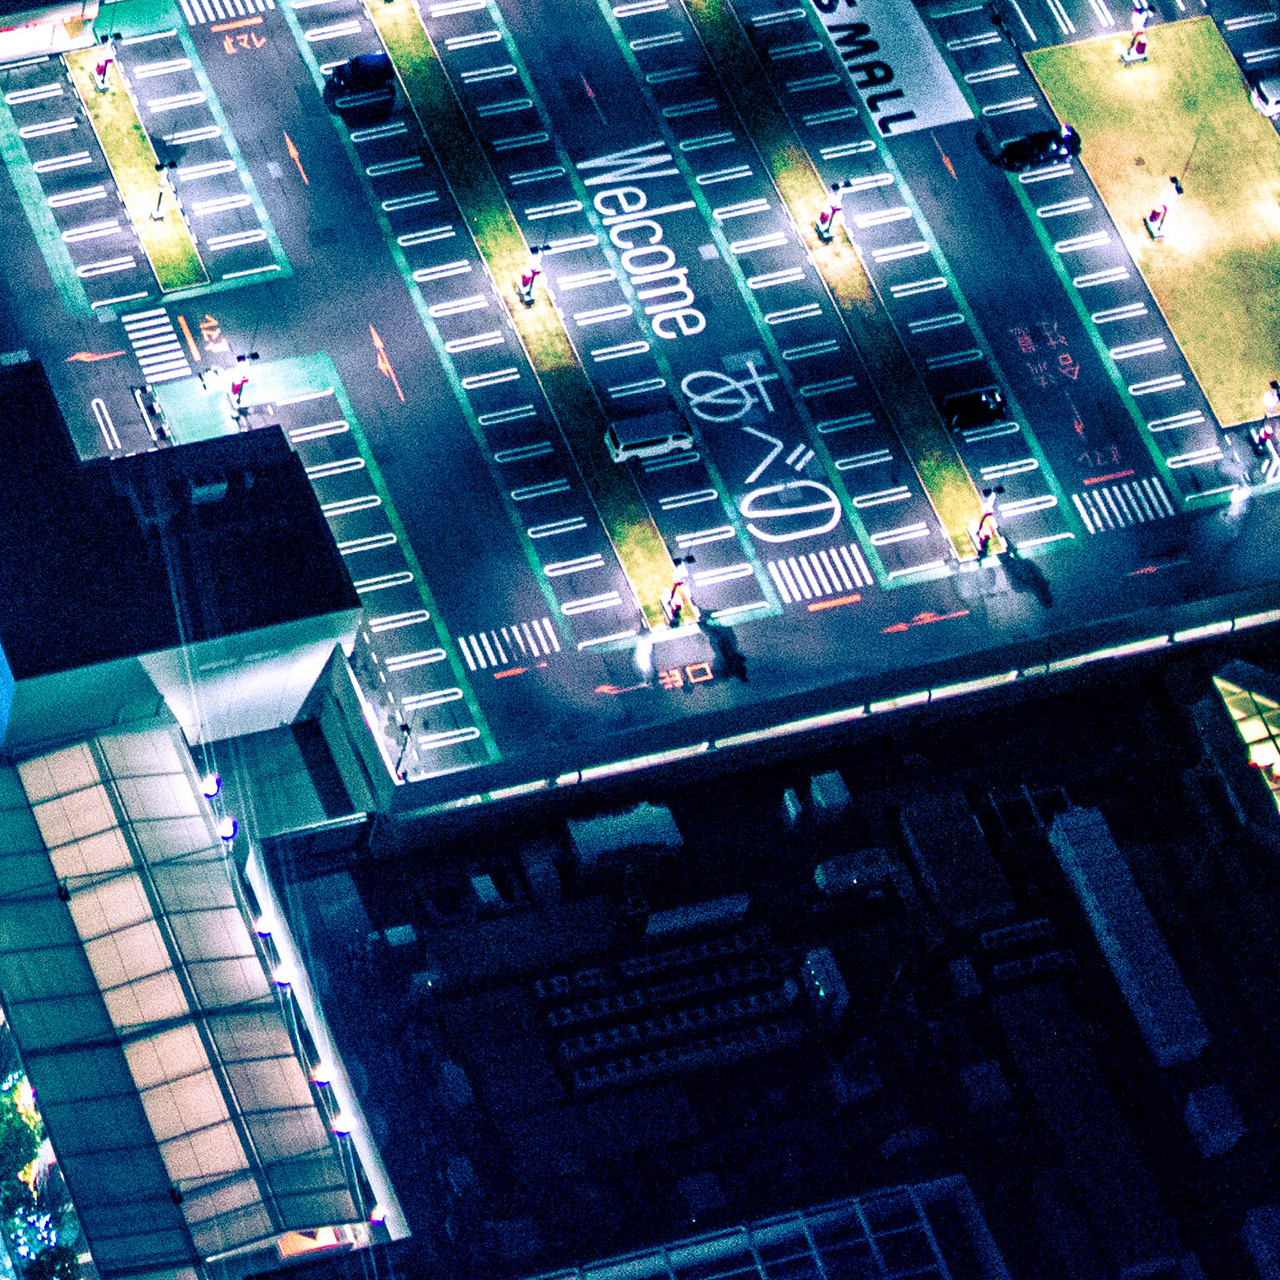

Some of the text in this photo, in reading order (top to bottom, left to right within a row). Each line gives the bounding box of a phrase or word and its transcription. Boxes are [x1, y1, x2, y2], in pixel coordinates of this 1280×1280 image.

[827, 23, 916, 134] MALL
[576, 141, 706, 339] Welcome
[681, 361, 842, 542] あべの
